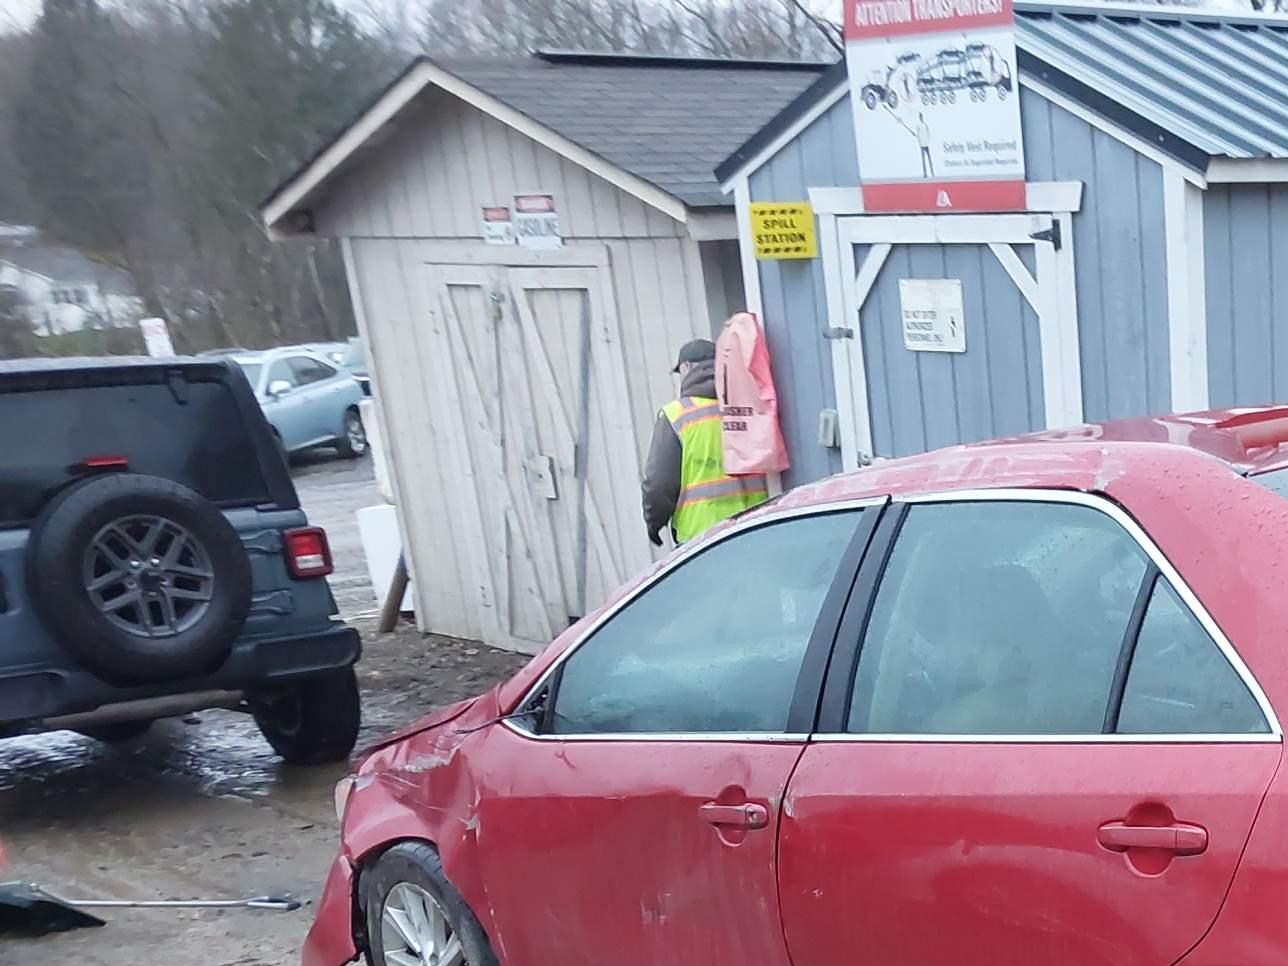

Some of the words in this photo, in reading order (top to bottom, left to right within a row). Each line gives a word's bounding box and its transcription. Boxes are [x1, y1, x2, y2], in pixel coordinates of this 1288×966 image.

[854, 0, 912, 27] ATTENTION
[762, 218, 797, 230] SPILL
[756, 232, 806, 245] STATION
